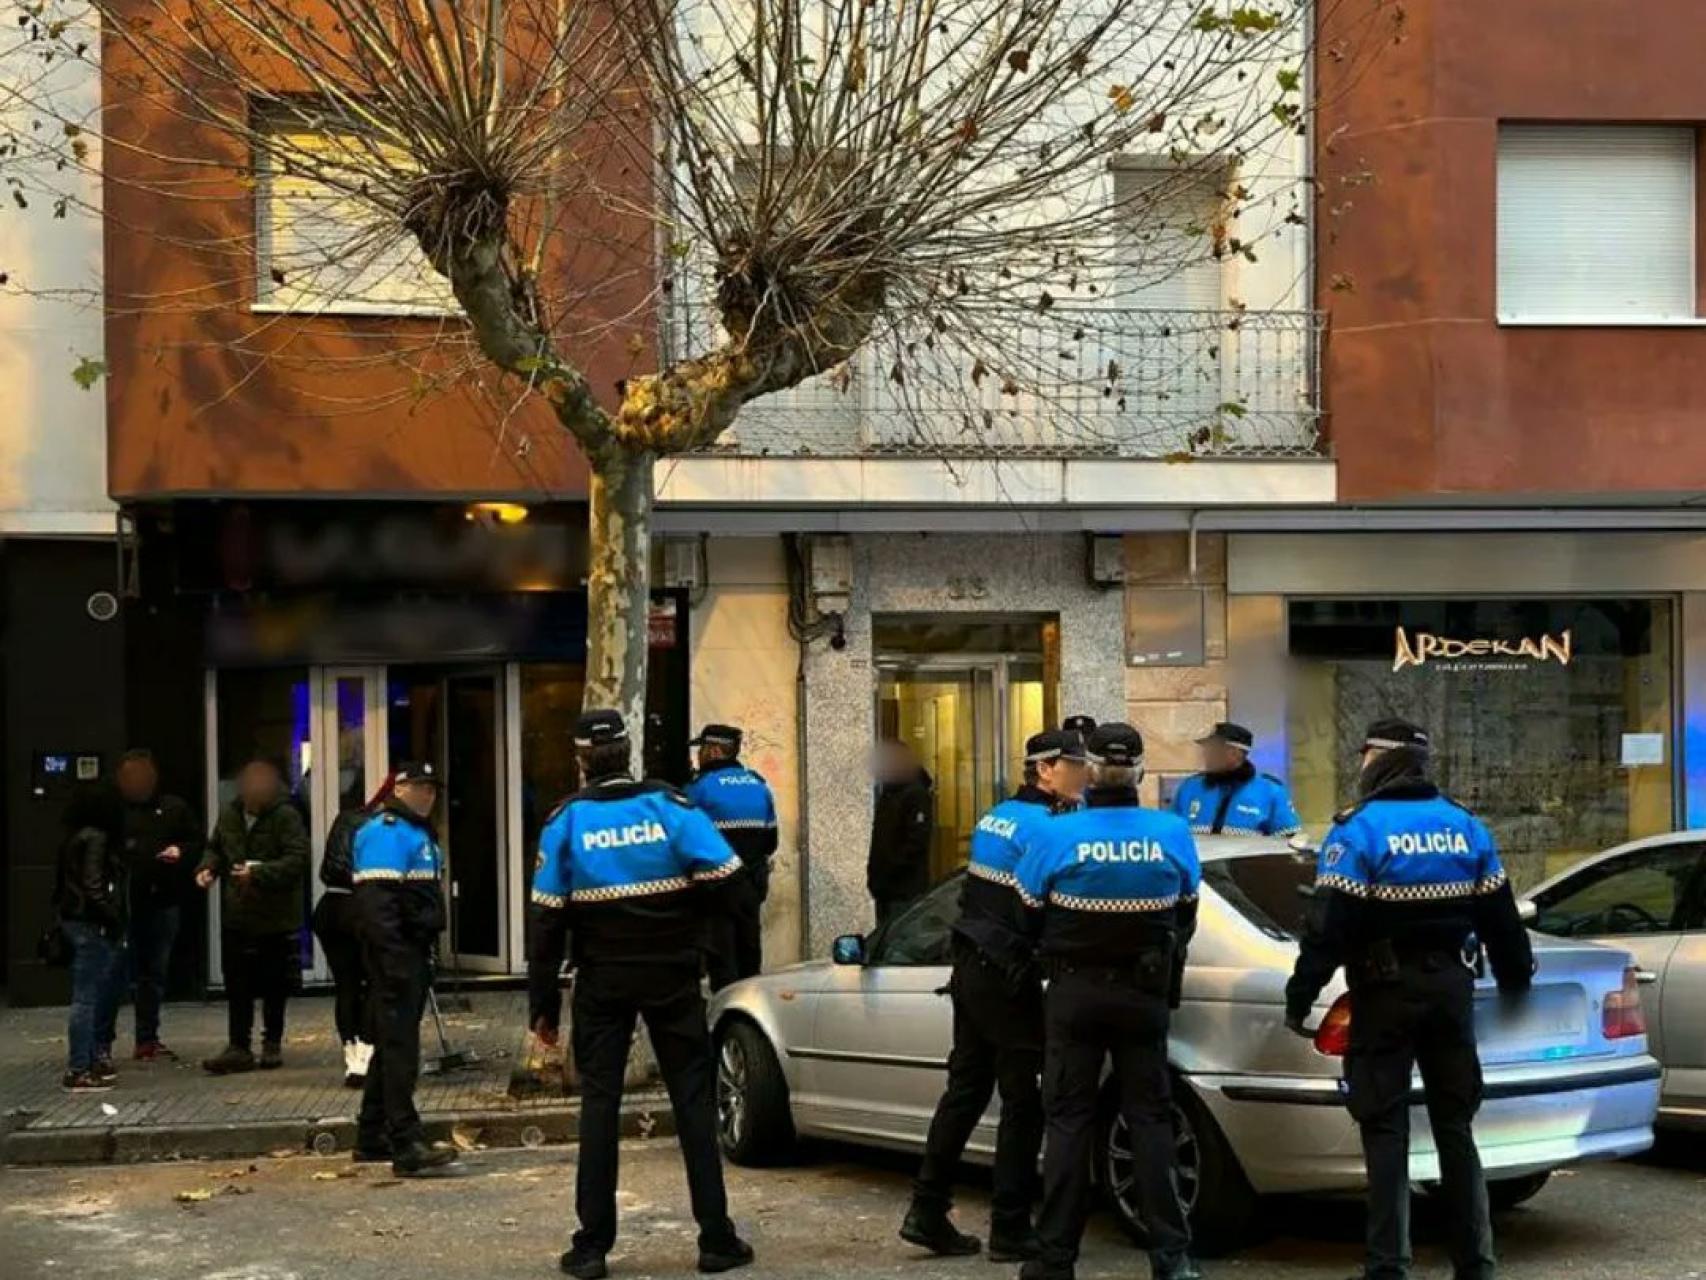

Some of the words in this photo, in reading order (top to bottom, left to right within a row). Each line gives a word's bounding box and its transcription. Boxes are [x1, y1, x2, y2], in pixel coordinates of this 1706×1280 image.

[1392, 625, 1571, 672] ARDEKAN
[582, 819, 667, 852] POLICÍA
[1077, 836, 1164, 864] POLICÍA
[1386, 827, 1470, 856] POLICÍA
